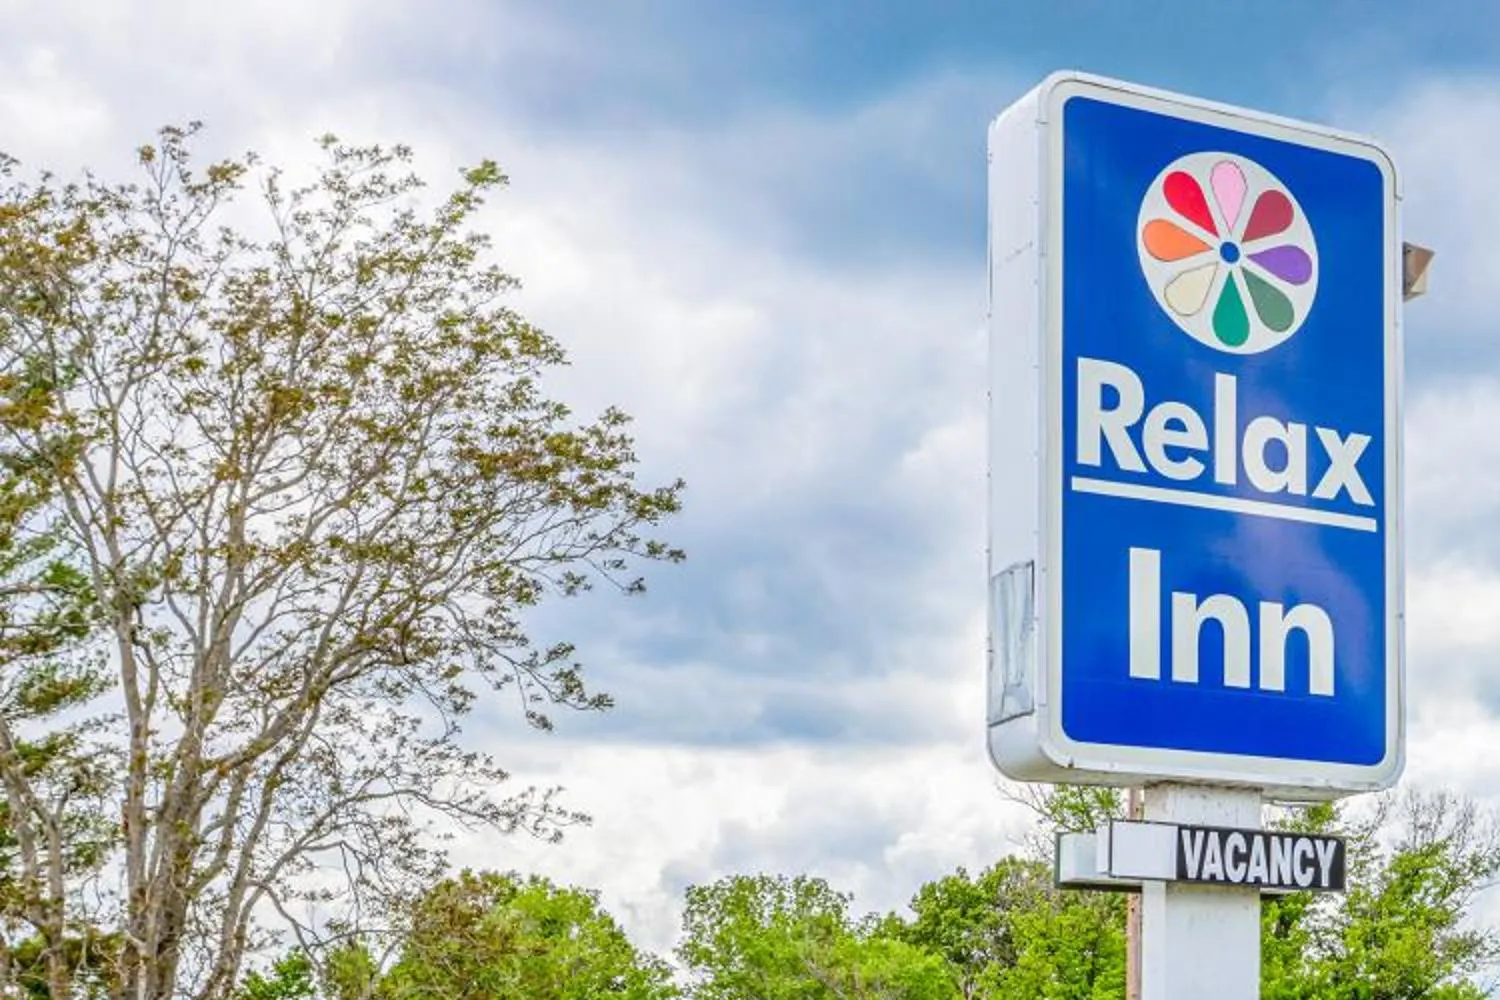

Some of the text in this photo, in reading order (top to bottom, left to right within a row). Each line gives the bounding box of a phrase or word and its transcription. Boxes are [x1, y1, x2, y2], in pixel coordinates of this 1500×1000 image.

[1077, 357, 1375, 506] Relax
[1129, 547, 1335, 696] Inn
[1181, 828, 1337, 888] VACANCY
